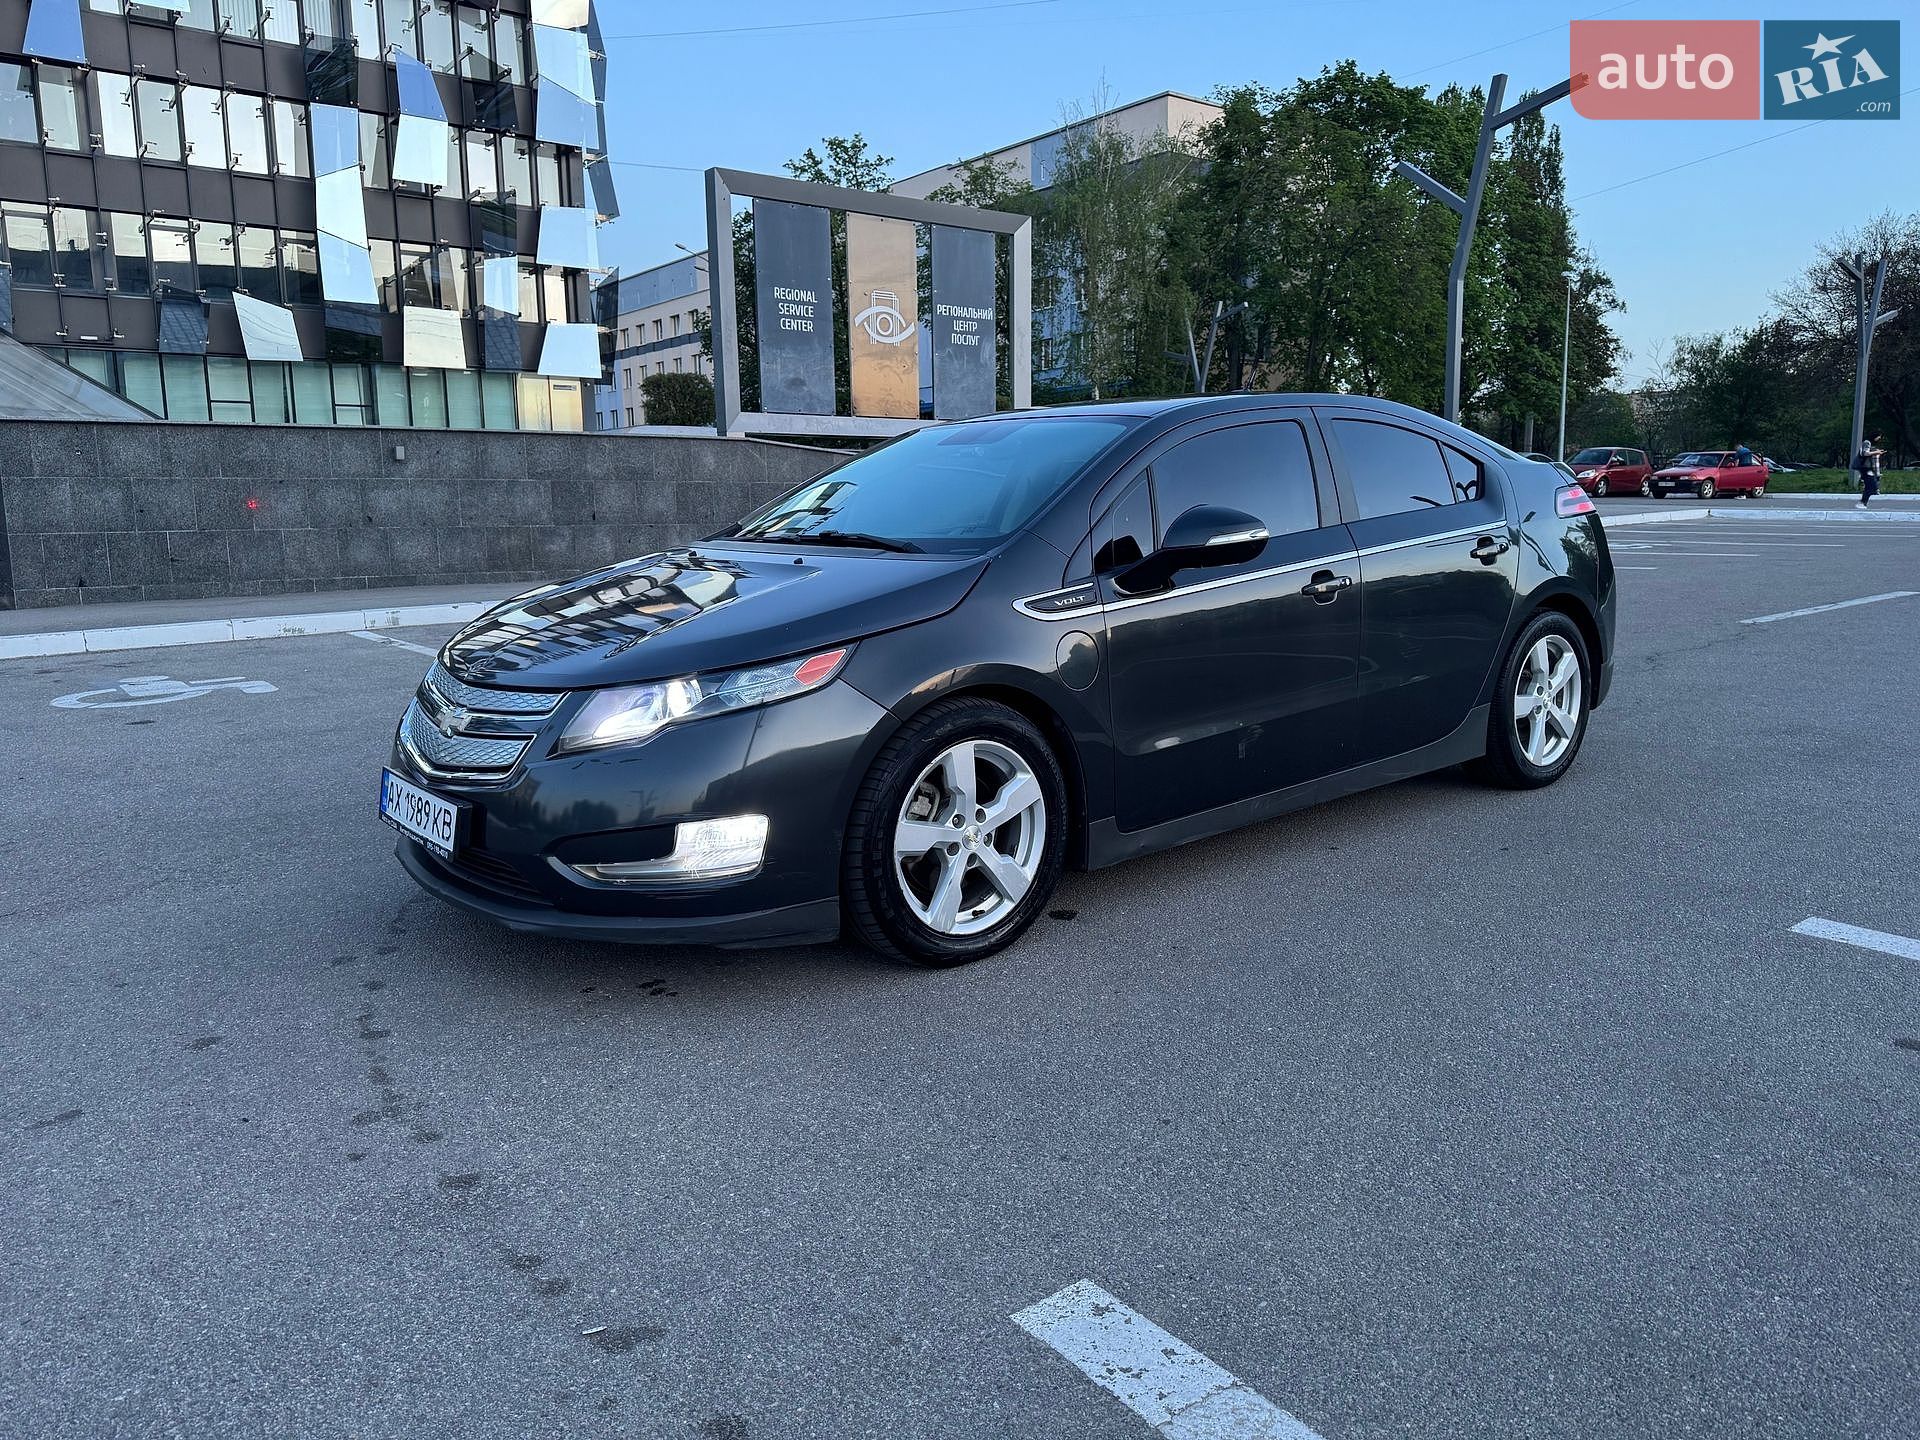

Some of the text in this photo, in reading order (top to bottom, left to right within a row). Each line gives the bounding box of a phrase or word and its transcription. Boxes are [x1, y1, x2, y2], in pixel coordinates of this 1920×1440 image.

[774, 286, 818, 303] REGIONAL
[778, 302, 814, 318] SERVICE
[936, 304, 993, 320] РЕГІОНАЛЬНИЙ
[780, 317, 814, 332] CENTER
[953, 319, 978, 332] ЦЕНТР
[951, 333, 980, 346] ПОСЛУГ
[1054, 595, 1086, 606] VOLT
[387, 780, 404, 817] AX
[432, 803, 452, 842] KB
